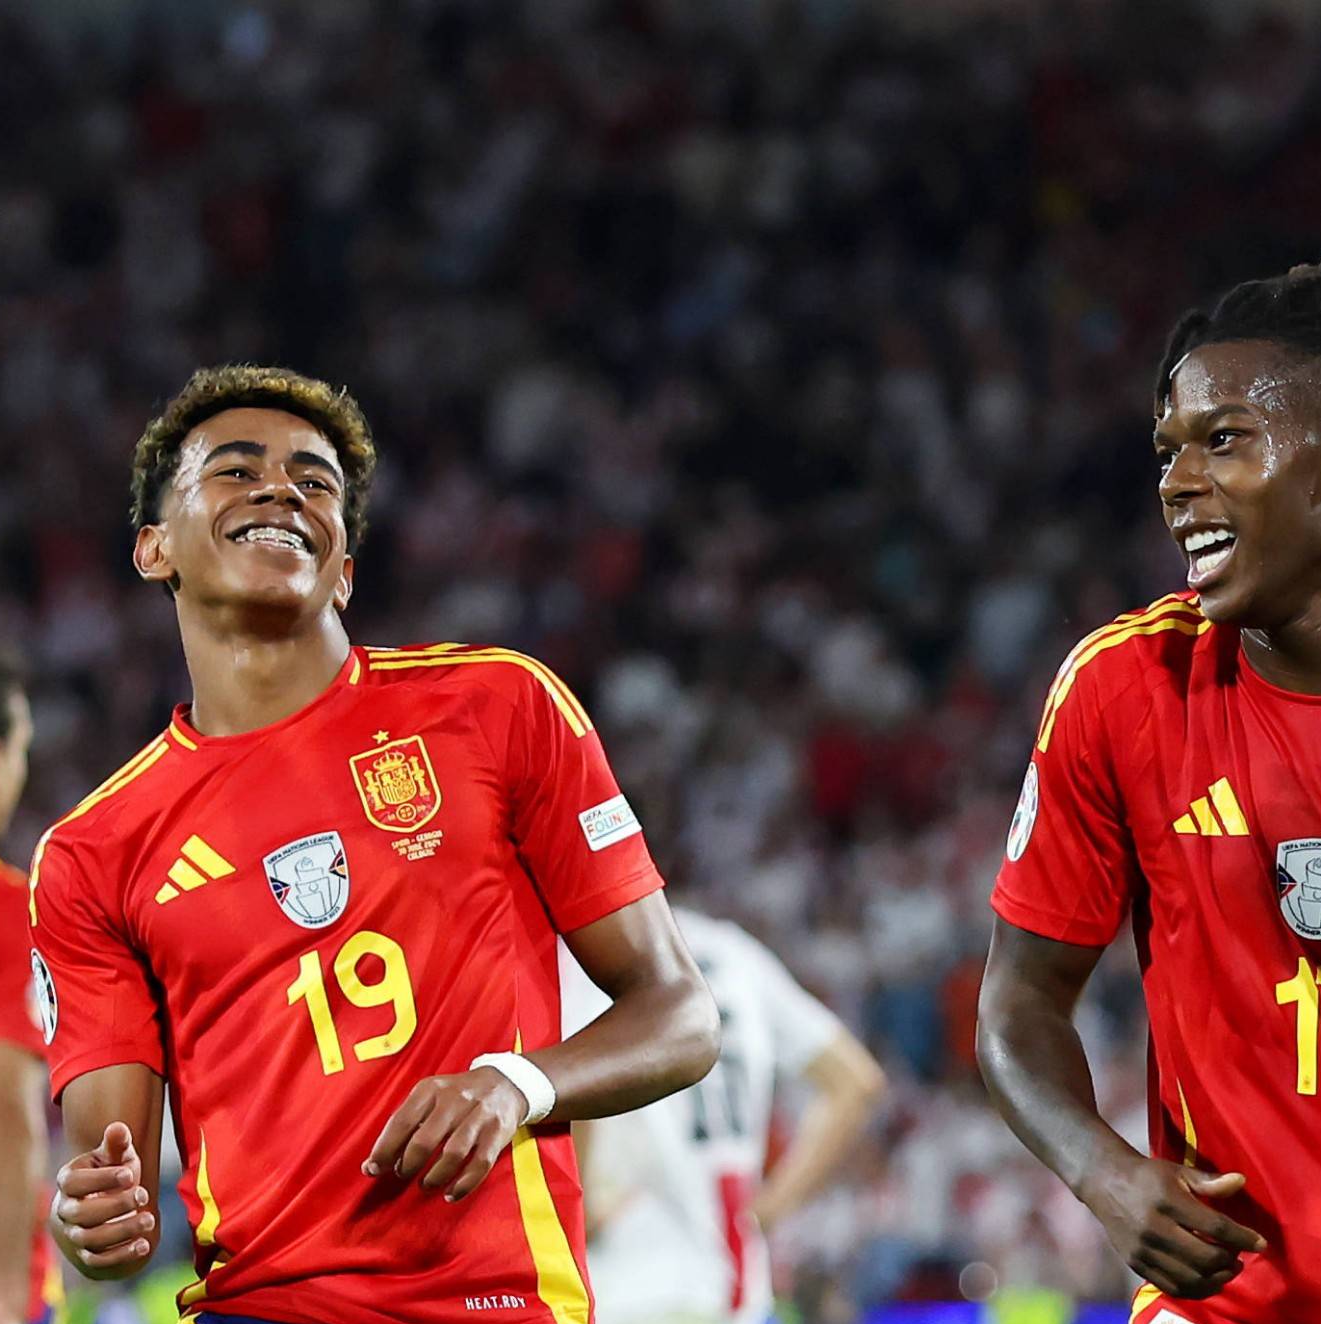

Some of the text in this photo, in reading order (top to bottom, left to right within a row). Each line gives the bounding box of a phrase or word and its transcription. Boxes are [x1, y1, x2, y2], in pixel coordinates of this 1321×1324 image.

[1281, 844, 1299, 852] UEFA
[286, 930, 418, 1077] 19
[465, 1294, 526, 1310] HEAT.RDY
